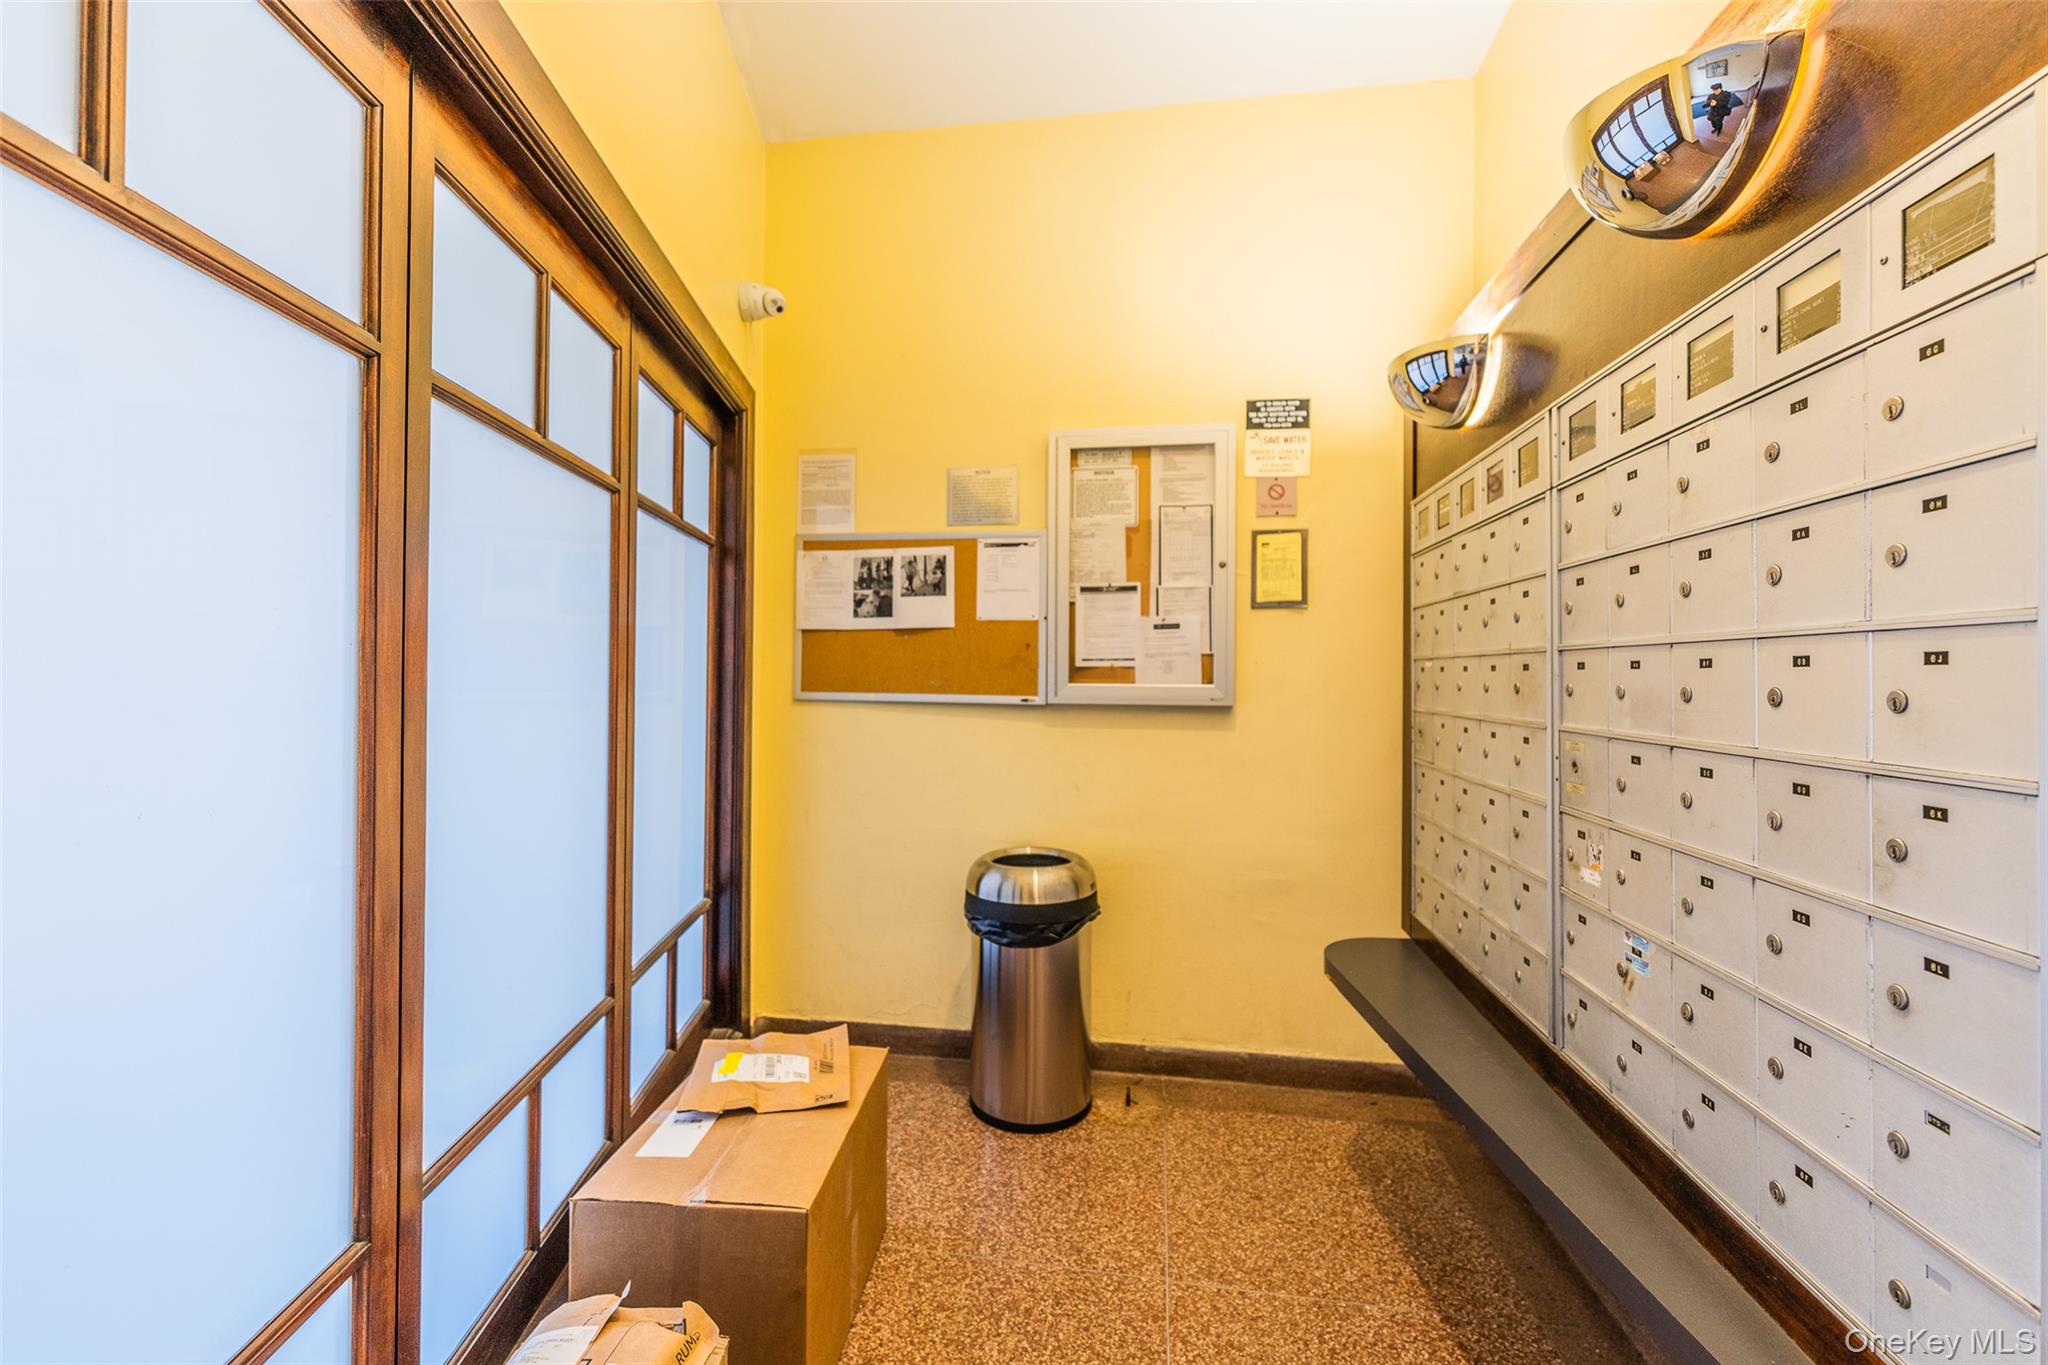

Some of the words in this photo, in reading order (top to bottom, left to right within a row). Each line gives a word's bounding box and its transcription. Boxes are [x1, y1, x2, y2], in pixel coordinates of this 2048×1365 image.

[1263, 436, 1279, 444] SAVE
[1284, 435, 1306, 444] WATER
[1930, 654, 1943, 663] 6J
[1930, 962, 1943, 974] 6L
